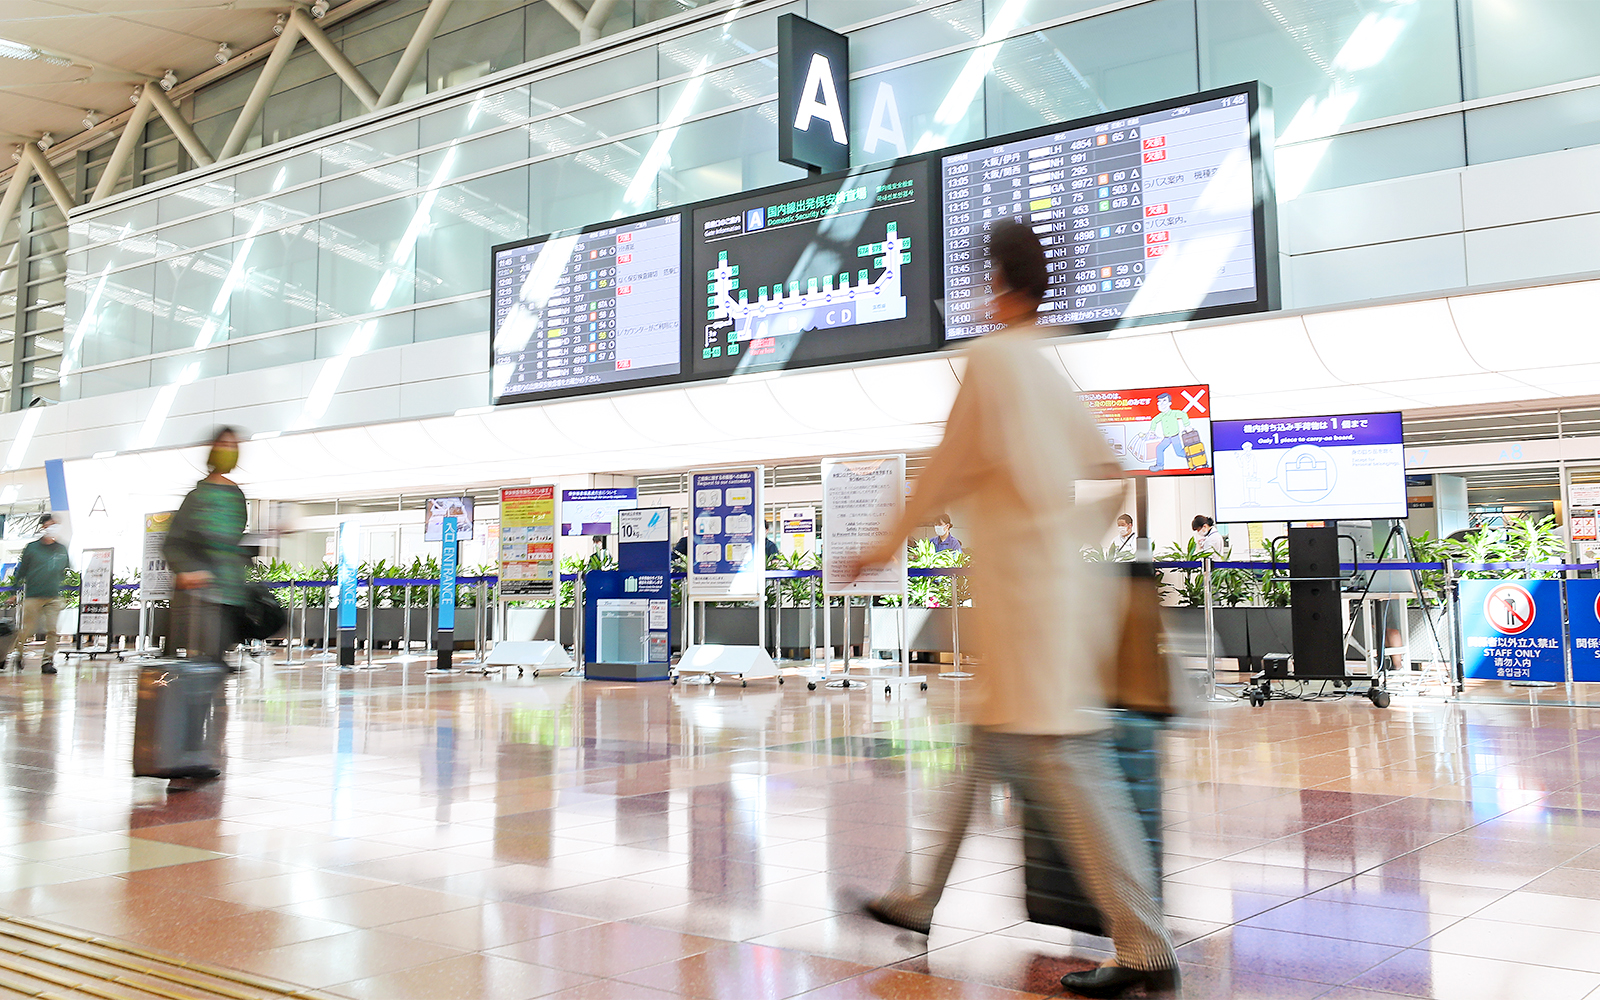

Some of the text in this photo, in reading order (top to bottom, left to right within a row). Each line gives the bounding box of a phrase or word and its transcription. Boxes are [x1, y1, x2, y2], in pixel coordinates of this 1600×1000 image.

[793, 53, 849, 146] A
[947, 164, 969, 176] 13:00
[1050, 145, 1062, 155] LH
[947, 176, 969, 188] 13:05
[1050, 157, 1064, 168] NH
[1070, 153, 1087, 163] 991
[947, 188, 969, 201] 13:05
[1050, 169, 1064, 180] NH
[948, 200, 970, 213] 13:15
[1071, 178, 1094, 190] 9972
[750, 211, 763, 229] A
[767, 187, 868, 218] 国内線出発保安検査場
[767, 213, 795, 226] Domestic
[795, 209, 821, 222] Security
[948, 213, 970, 225] 13:15
[1072, 193, 1084, 203] 75
[949, 225, 970, 238] 13:20
[1053, 208, 1066, 219] NH
[949, 238, 970, 250] 13:25
[1053, 222, 1066, 232] NH
[949, 251, 970, 262] 13:45
[1053, 235, 1065, 244] LH
[1115, 224, 1127, 234] 47
[949, 264, 970, 275] 13:45
[1054, 246, 1067, 256] NH
[1074, 244, 1090, 255] 997
[950, 276, 971, 287] 13:50
[1054, 260, 1067, 270] HD
[1074, 258, 1086, 268] 25
[950, 288, 971, 299] 13:50
[1054, 274, 1066, 283] LH
[950, 300, 971, 312] 14:00
[1055, 287, 1067, 297] LH
[1075, 283, 1097, 294] 4900
[826, 310, 835, 325] C
[841, 308, 852, 323] D
[950, 313, 971, 325] 14:00
[1055, 300, 1069, 310] NH
[1075, 297, 1087, 308] 67
[947, 322, 1008, 337] 搭乗口と最寄りの
[1243, 418, 1368, 434] 機内持ち込み手荷物は 1 個まで
[1258, 437, 1273, 446] Only
[1272, 433, 1279, 444] 1
[1280, 437, 1297, 445] piece
[1306, 435, 1333, 443] carry-on
[1333, 434, 1355, 442] board.
[1408, 450, 1429, 466] A7
[1499, 443, 1523, 461] A8
[88, 495, 108, 517] A
[621, 525, 633, 538] 10
[442, 523, 456, 605] 入口 ENTRANCE
[1467, 636, 1559, 649] 者以外立入禁止
[1483, 649, 1541, 658] STAFF ONLY
[1494, 658, 1532, 668] 请勿入内
[1496, 668, 1530, 677] 출입금지
